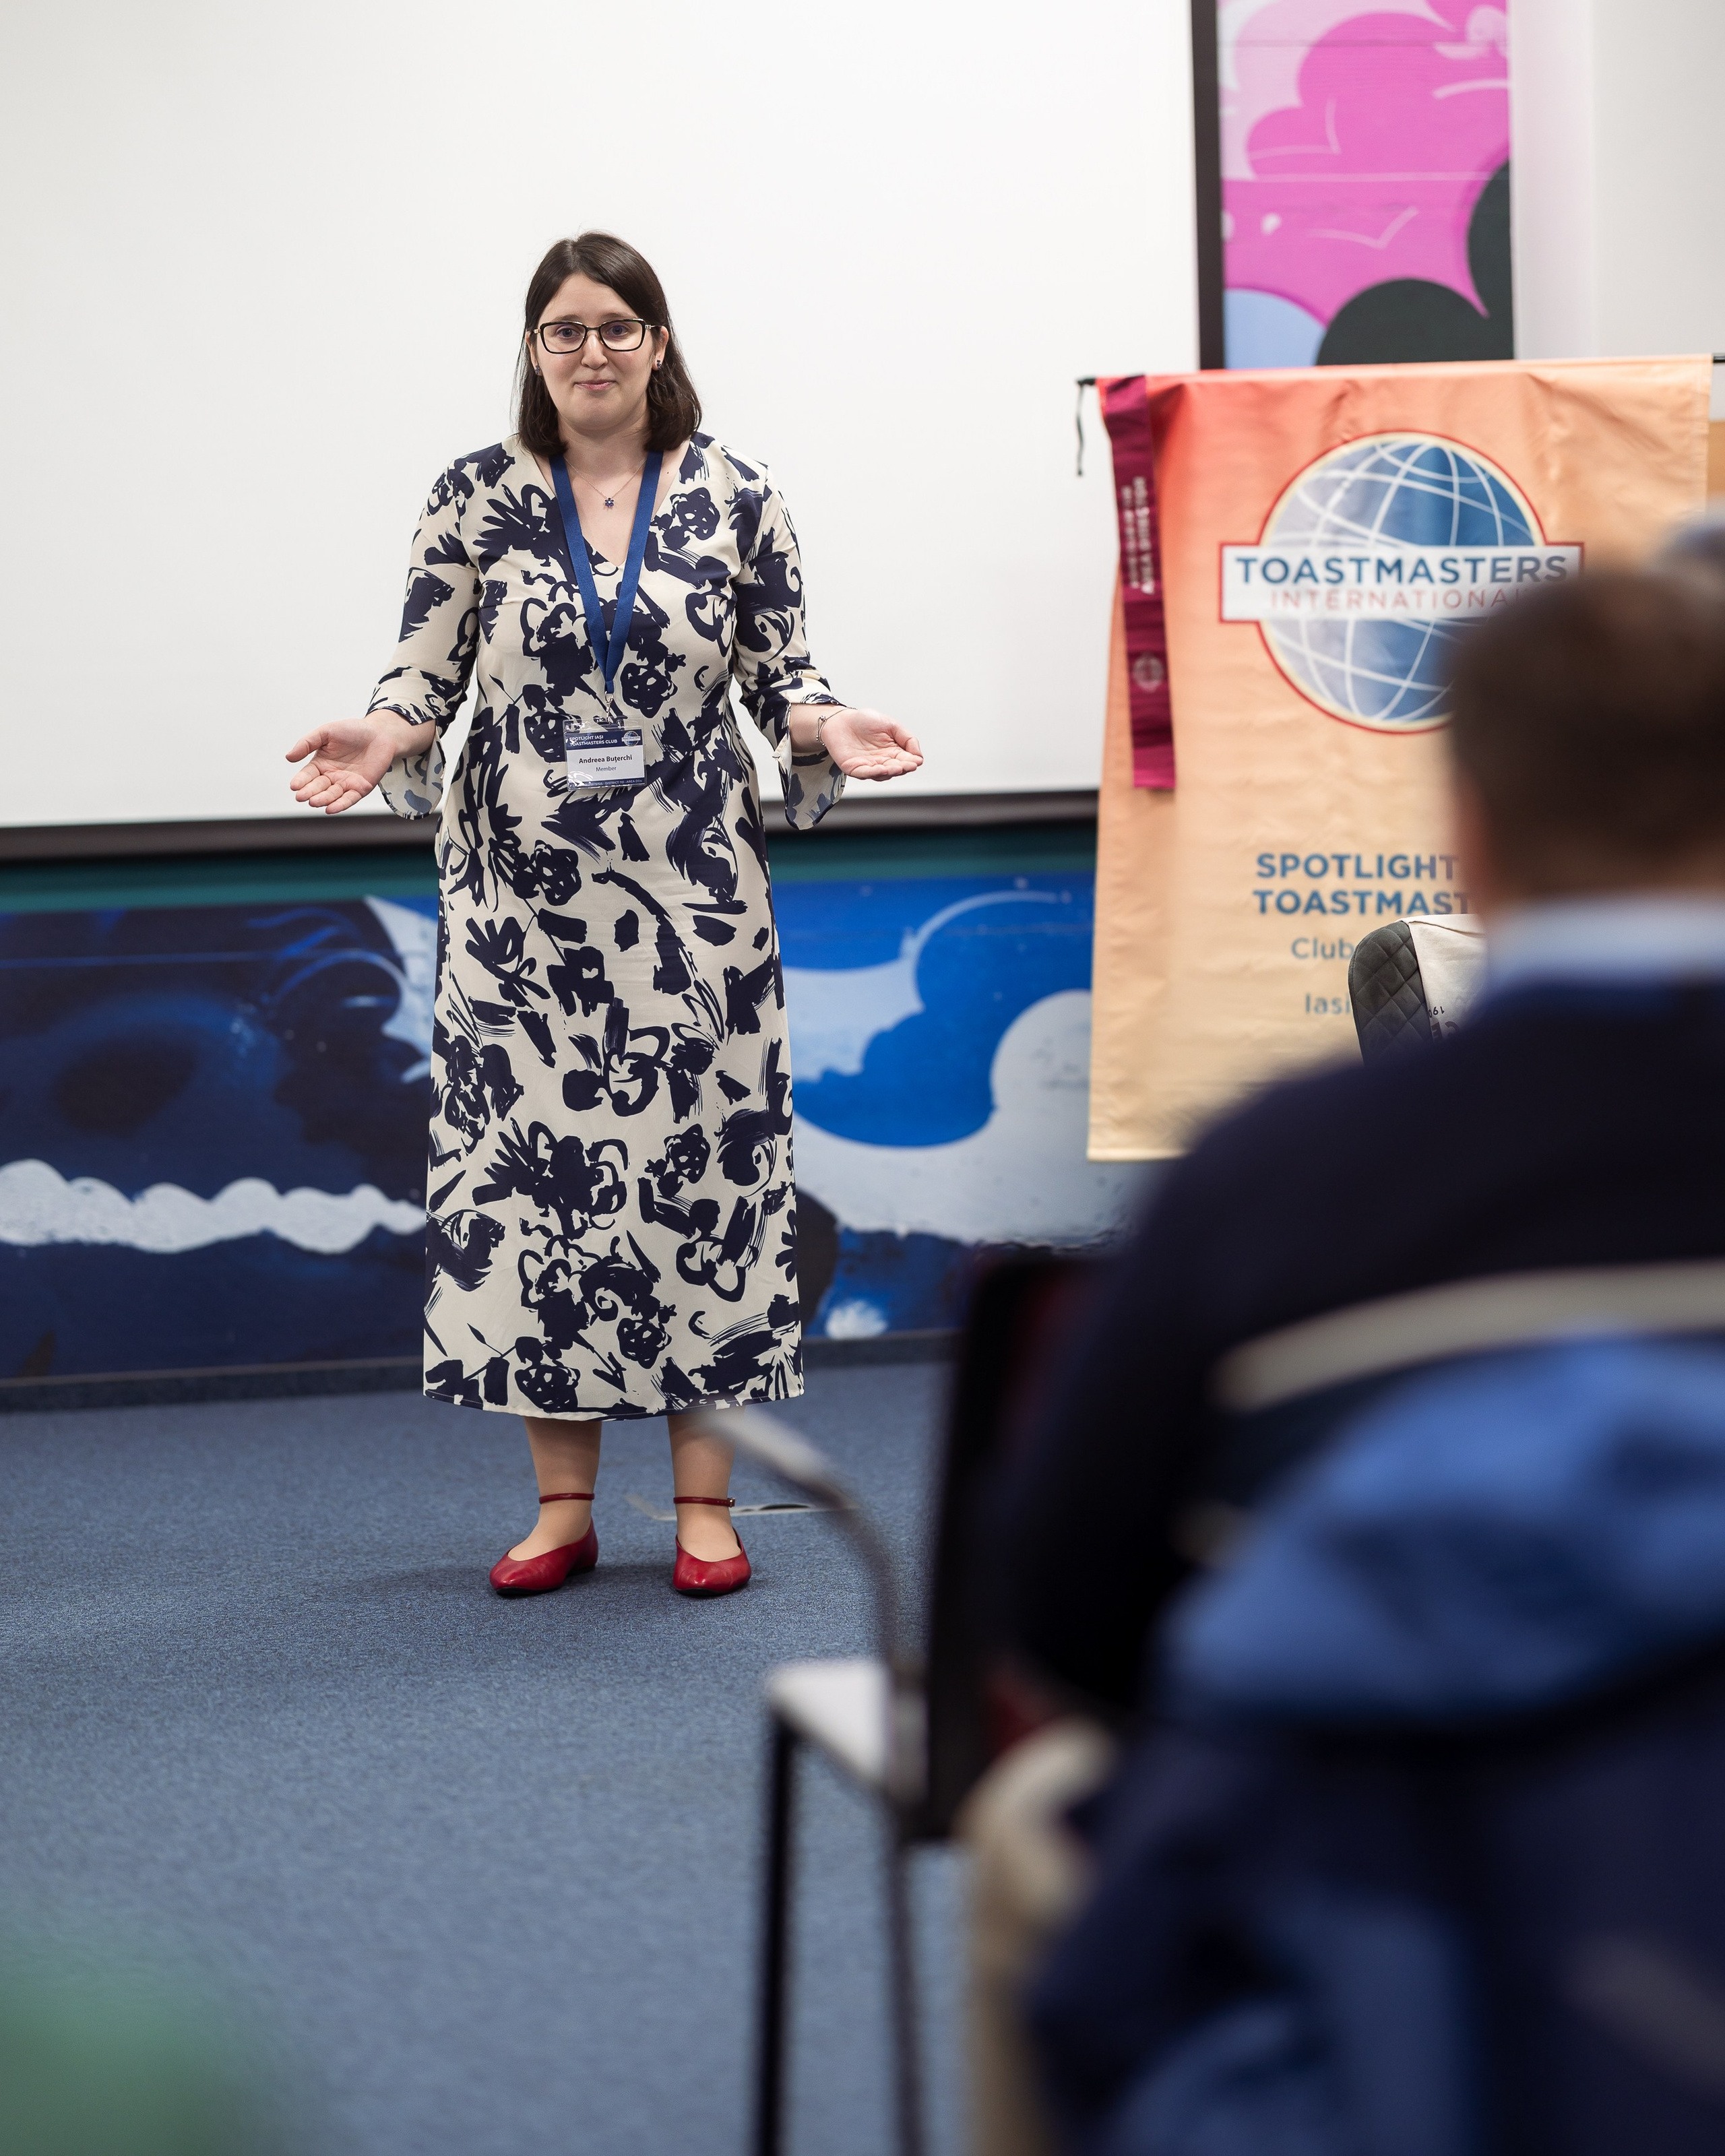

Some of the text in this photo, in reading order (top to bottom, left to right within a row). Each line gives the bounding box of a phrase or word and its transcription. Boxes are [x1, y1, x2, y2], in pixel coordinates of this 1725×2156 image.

[1236, 554, 1568, 585] TOASTMASTERS
[1256, 853, 1459, 879] SPOTLIGHT
[1252, 889, 1470, 915] TOASTMAST
[1290, 937, 1354, 959] Club
